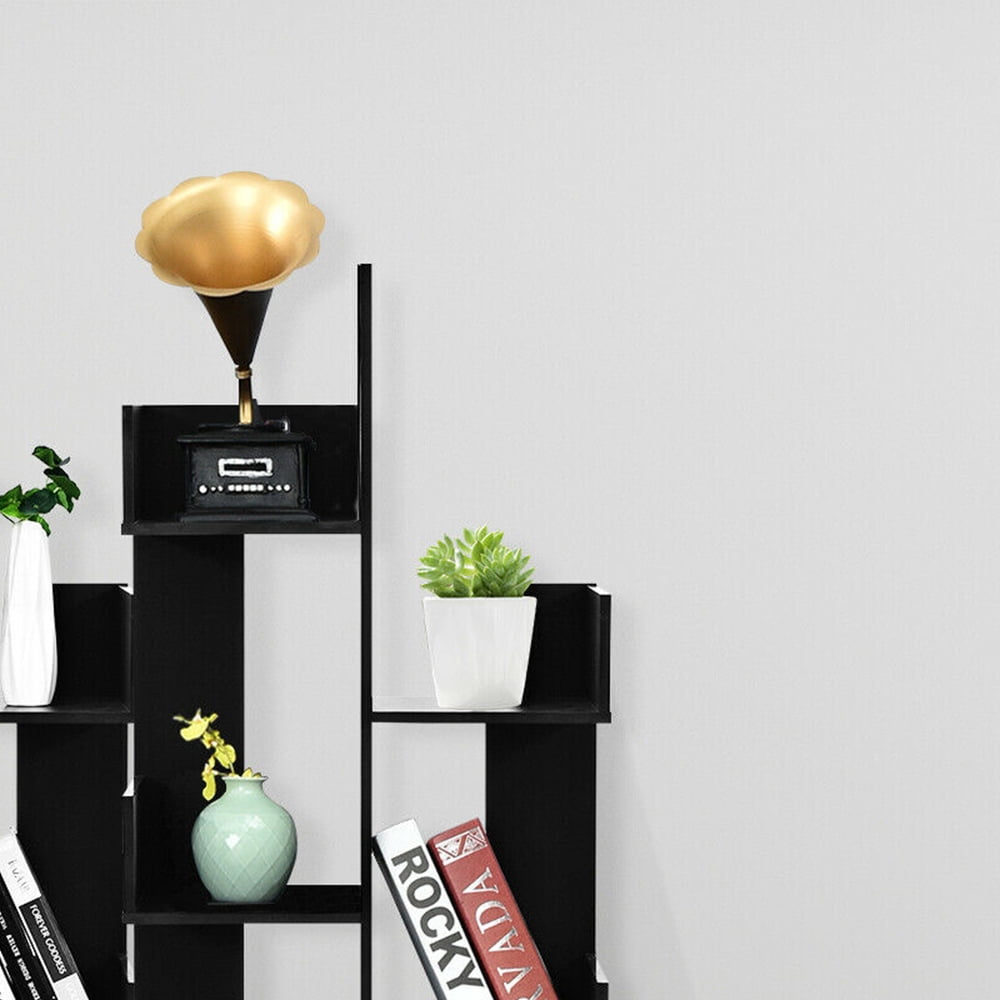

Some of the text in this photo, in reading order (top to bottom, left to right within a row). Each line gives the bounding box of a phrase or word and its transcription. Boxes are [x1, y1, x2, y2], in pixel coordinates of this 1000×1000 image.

[29, 903, 67, 975] FOREVER GODDESS
[391, 845, 484, 991] ROCKY
